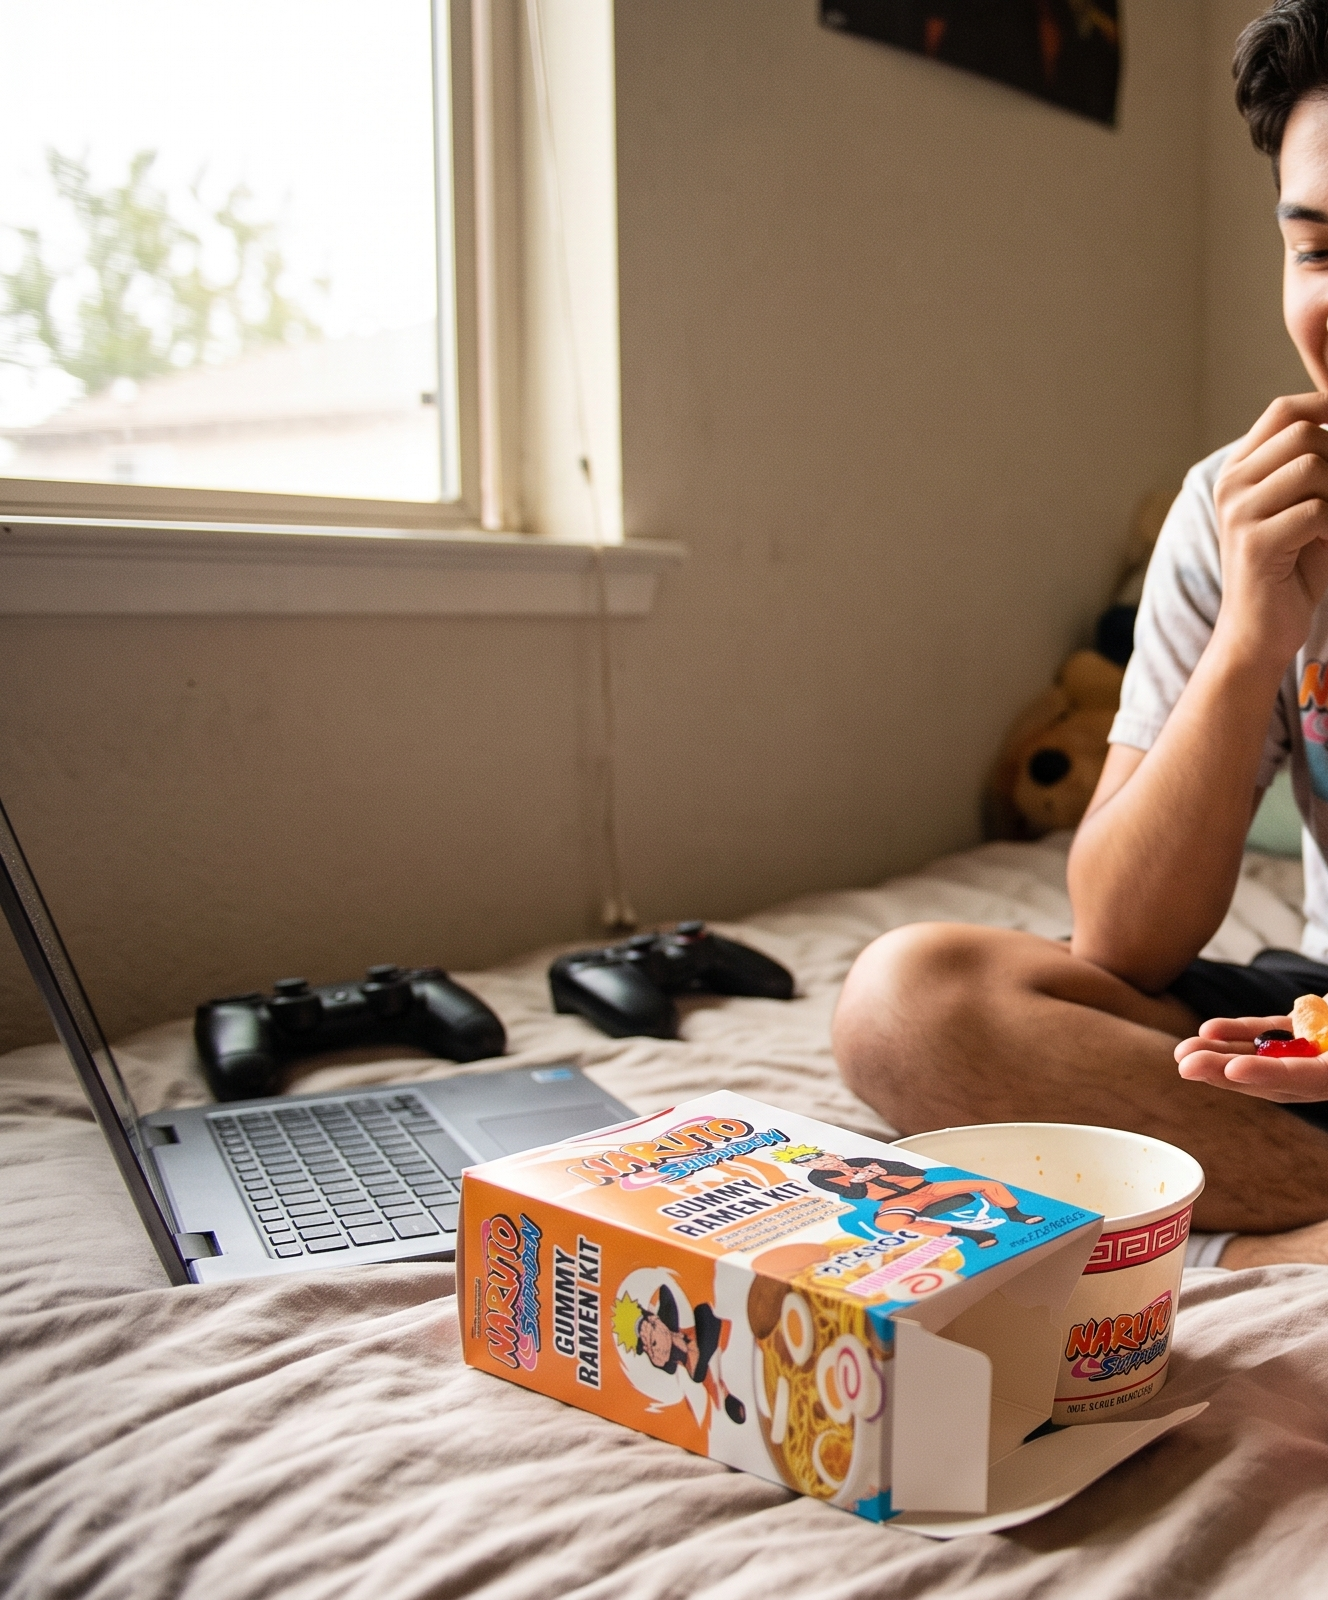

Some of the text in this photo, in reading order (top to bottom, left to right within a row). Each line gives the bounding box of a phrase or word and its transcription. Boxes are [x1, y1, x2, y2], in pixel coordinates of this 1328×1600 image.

[566, 1118, 755, 1186] NARUTO
[661, 1179, 762, 1219] GUMMY
[673, 1197, 772, 1237] RAMEN
[761, 1182, 810, 1202] KIT
[485, 1214, 520, 1369] NARUTO
[555, 1248, 575, 1356] GUMMY
[578, 1237, 599, 1387] RAMEN KIT
[1065, 1298, 1173, 1362] NARUTO
